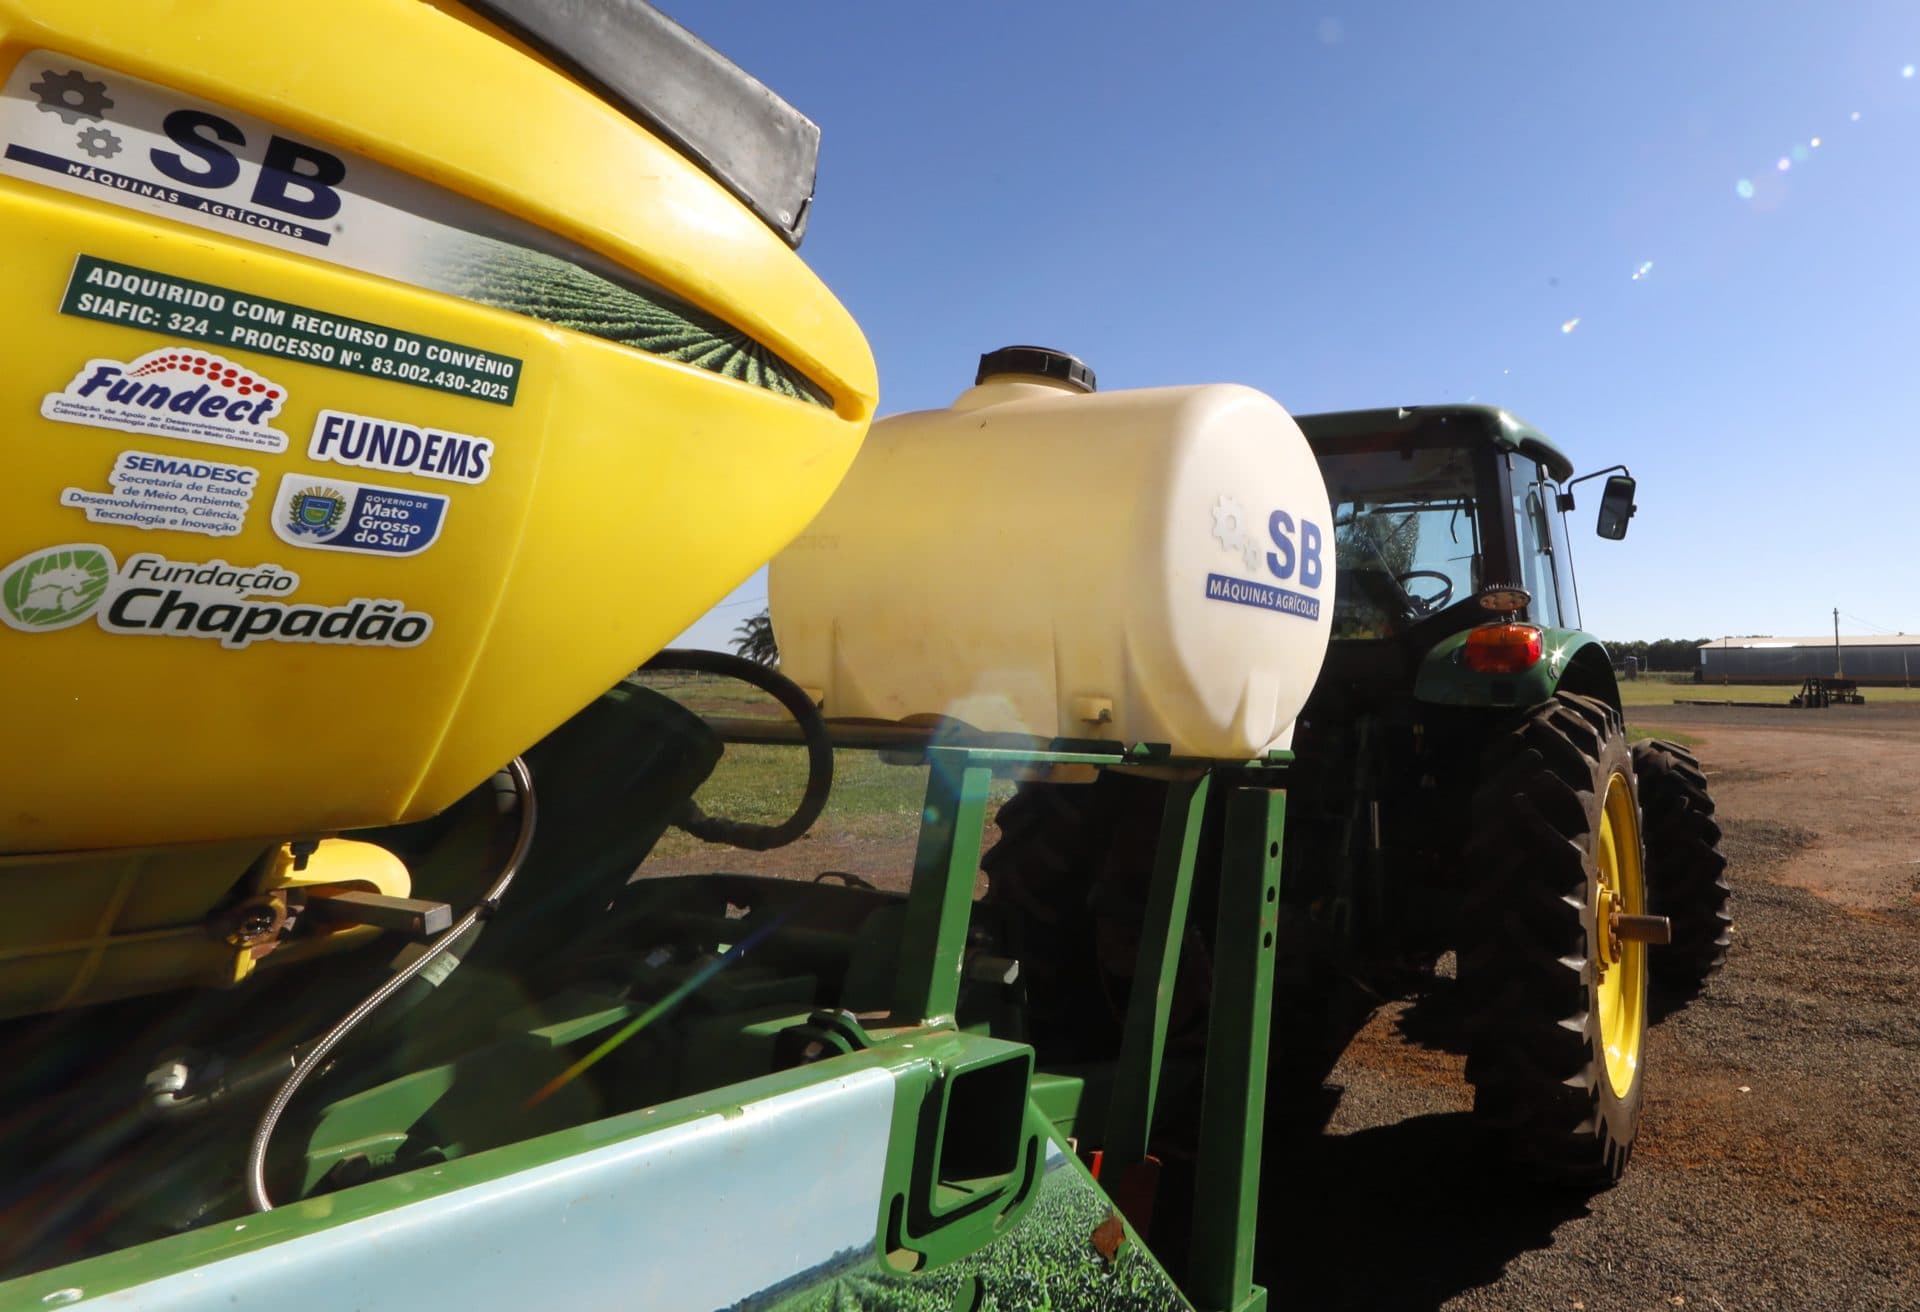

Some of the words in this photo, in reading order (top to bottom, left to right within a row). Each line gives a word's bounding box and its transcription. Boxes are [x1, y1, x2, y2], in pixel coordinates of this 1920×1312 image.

[150, 109, 346, 220] SB
[67, 163, 179, 204] MÁQUINAS
[198, 200, 303, 238] AGRÍCOLAS
[86, 267, 225, 312] ADQUIRIDO
[232, 300, 285, 326] COM
[291, 313, 388, 349] RECURSO
[394, 337, 420, 356] DO
[426, 345, 514, 379] CONVÊNIO
[77, 293, 161, 326] SIAFIC:
[167, 312, 208, 336] 324
[230, 325, 334, 362] PROCESSO
[371, 357, 509, 400] 83.002.430-2025
[55, 400, 101, 412] Fundação
[120, 411, 146, 420] Apoio
[77, 366, 274, 425] Fundect
[99, 414, 145, 426] Tecnologia
[317, 416, 488, 480] FUNDEMS
[117, 472, 183, 489] Secretaria
[186, 481, 203, 492] de
[206, 485, 248, 498] Estado
[124, 455, 254, 485] SEMADESC
[69, 492, 188, 515] Desenvolvimento,
[192, 506, 241, 521] Ciência,
[122, 486, 140, 496] de
[143, 488, 177, 501] Meio
[179, 493, 244, 510] Ambiente,
[362, 502, 409, 520] Mato
[365, 494, 413, 508] GOVERNO
[415, 501, 428, 510] DE
[94, 508, 166, 527] Tecnologia
[169, 517, 178, 526] e
[181, 517, 237, 533] Inovação
[358, 516, 421, 535] Grosso
[353, 530, 379, 544] do
[380, 533, 410, 547] Sul
[1266, 509, 1323, 590] SB
[128, 559, 293, 595] Fundação
[1210, 579, 1273, 606] MÁQUINAS
[1275, 594, 1318, 618] AGRÍCOLAS
[107, 587, 428, 644] Chapadão
